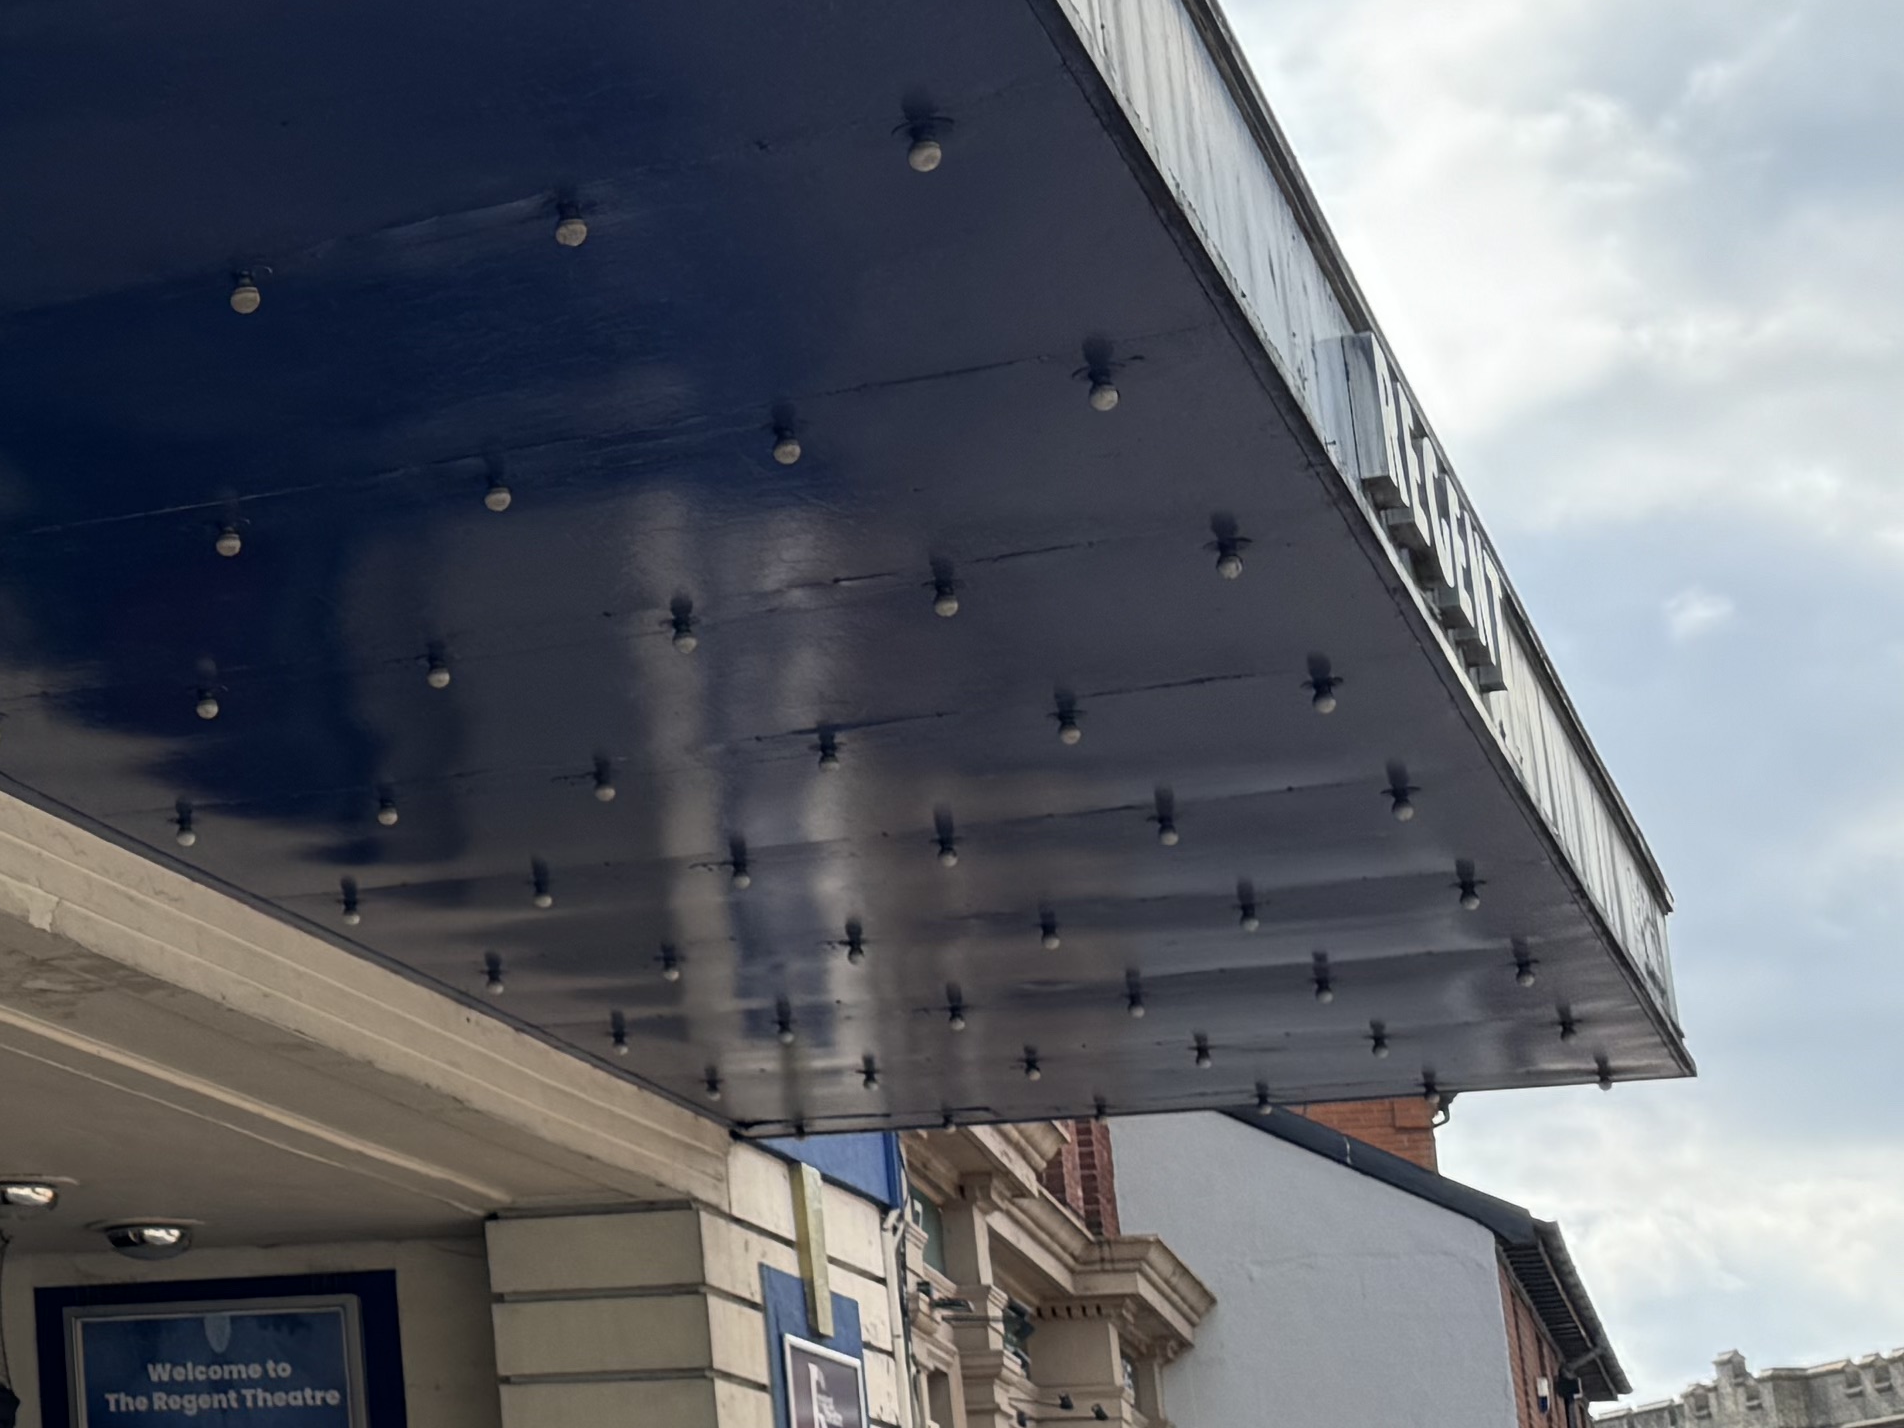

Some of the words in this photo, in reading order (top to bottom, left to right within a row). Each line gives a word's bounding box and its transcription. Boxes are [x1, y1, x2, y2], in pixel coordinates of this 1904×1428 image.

[1373, 333, 1507, 689] REGENT
[147, 1360, 262, 1384] Welcome
[267, 1360, 292, 1380] to
[105, 1390, 149, 1414] The
[152, 1387, 238, 1415] Regent
[241, 1386, 341, 1409] Theatre
